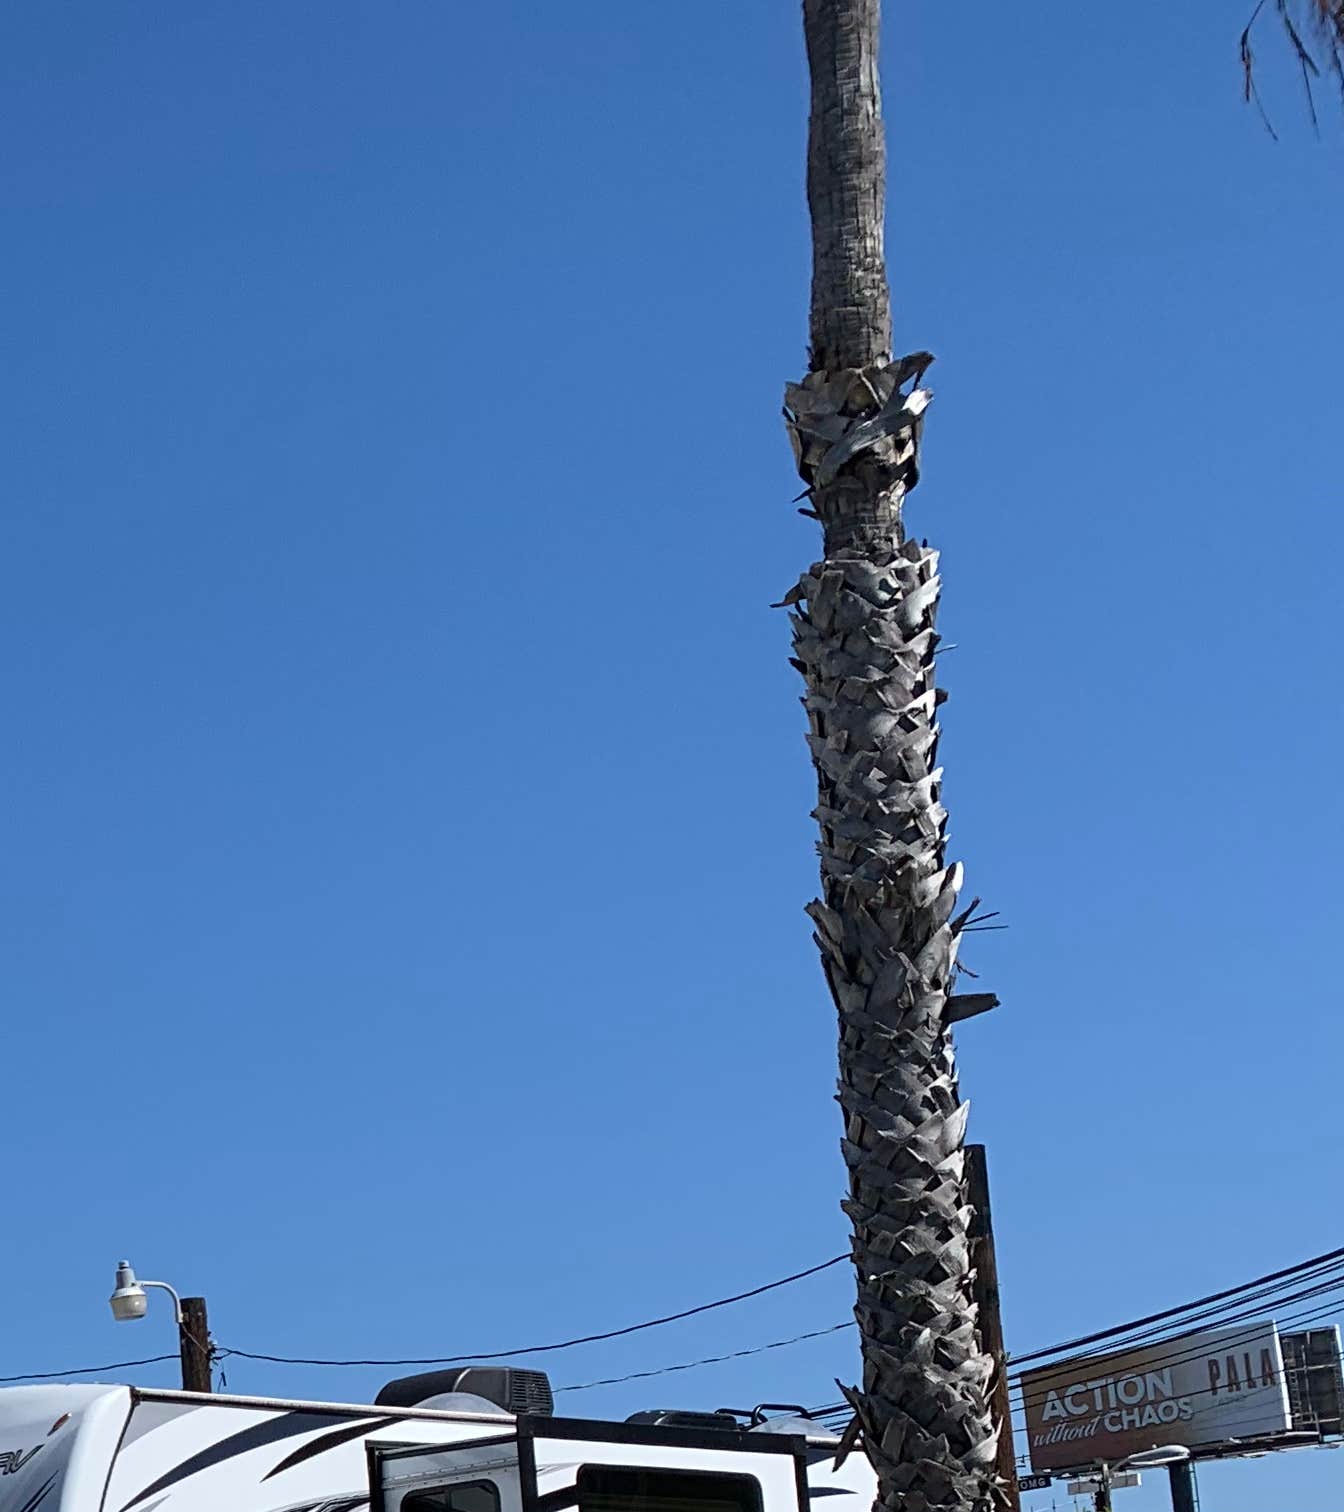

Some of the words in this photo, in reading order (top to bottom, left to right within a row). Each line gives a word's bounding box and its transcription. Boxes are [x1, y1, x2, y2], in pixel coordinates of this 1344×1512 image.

[1041, 1367, 1174, 1422] ACTION
[1207, 1348, 1277, 1396] PALA
[1033, 1416, 1102, 1448] without
[1103, 1397, 1194, 1433] CHAOS
